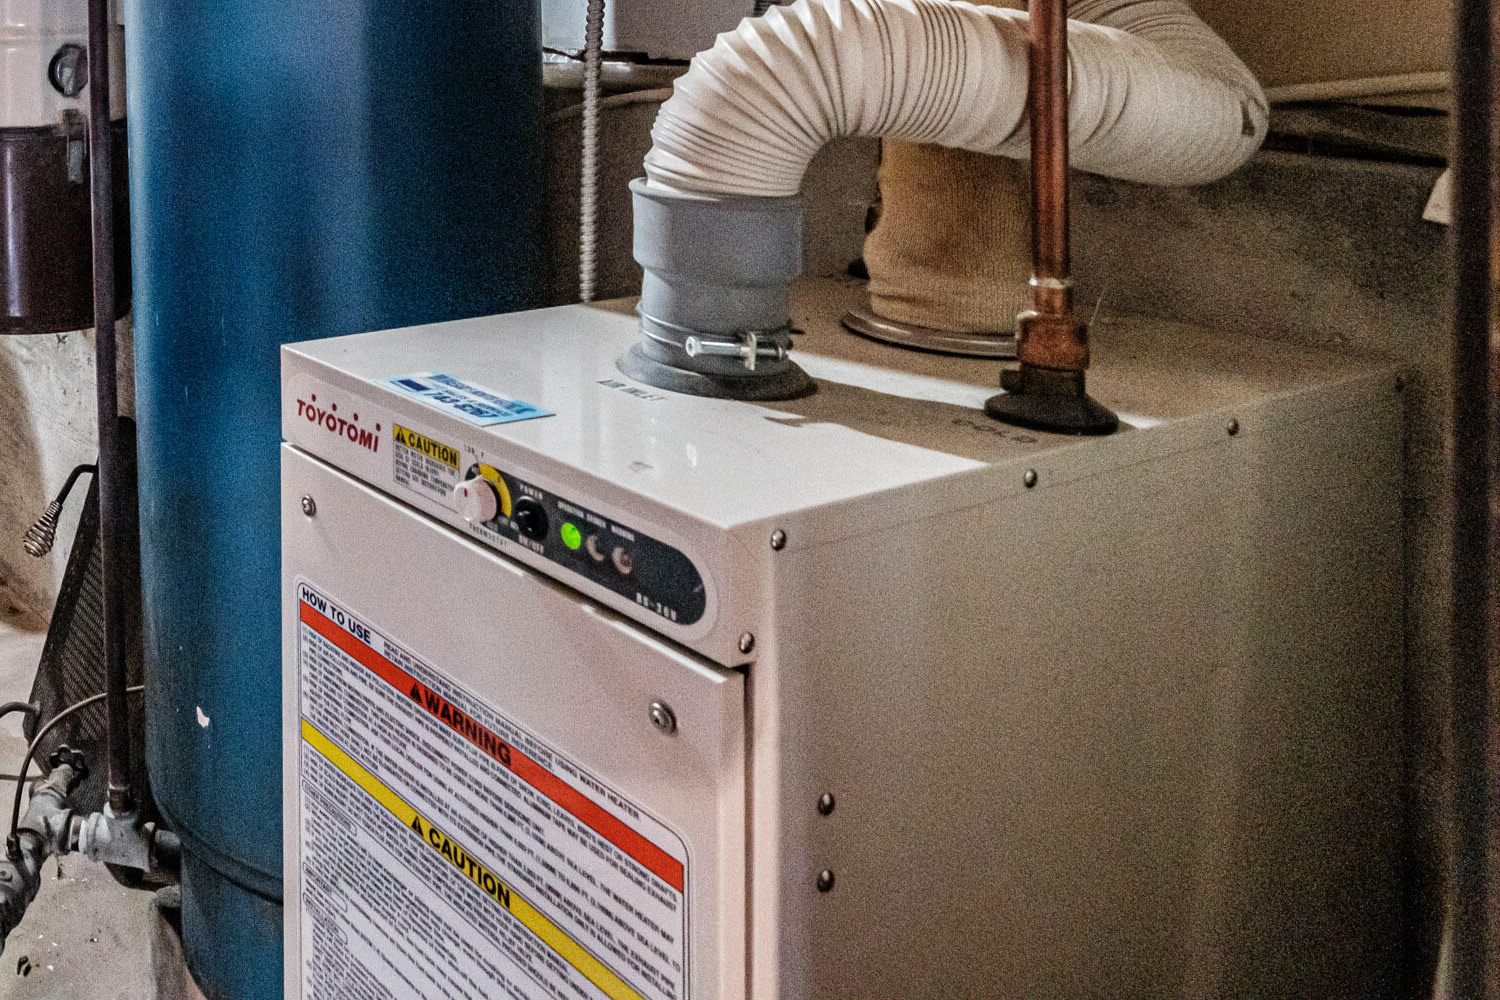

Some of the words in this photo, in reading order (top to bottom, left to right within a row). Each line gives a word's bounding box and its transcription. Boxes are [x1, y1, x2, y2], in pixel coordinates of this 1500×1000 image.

[296, 393, 382, 453] TOYOTOMI
[408, 432, 458, 466] CAUTION
[302, 586, 327, 613] HOW
[330, 605, 345, 625] TO
[348, 618, 371, 645] USE
[424, 689, 512, 767] WARNING
[495, 716, 522, 741] MANUAL
[579, 773, 605, 798] WATER
[428, 827, 511, 910] CAUTION
